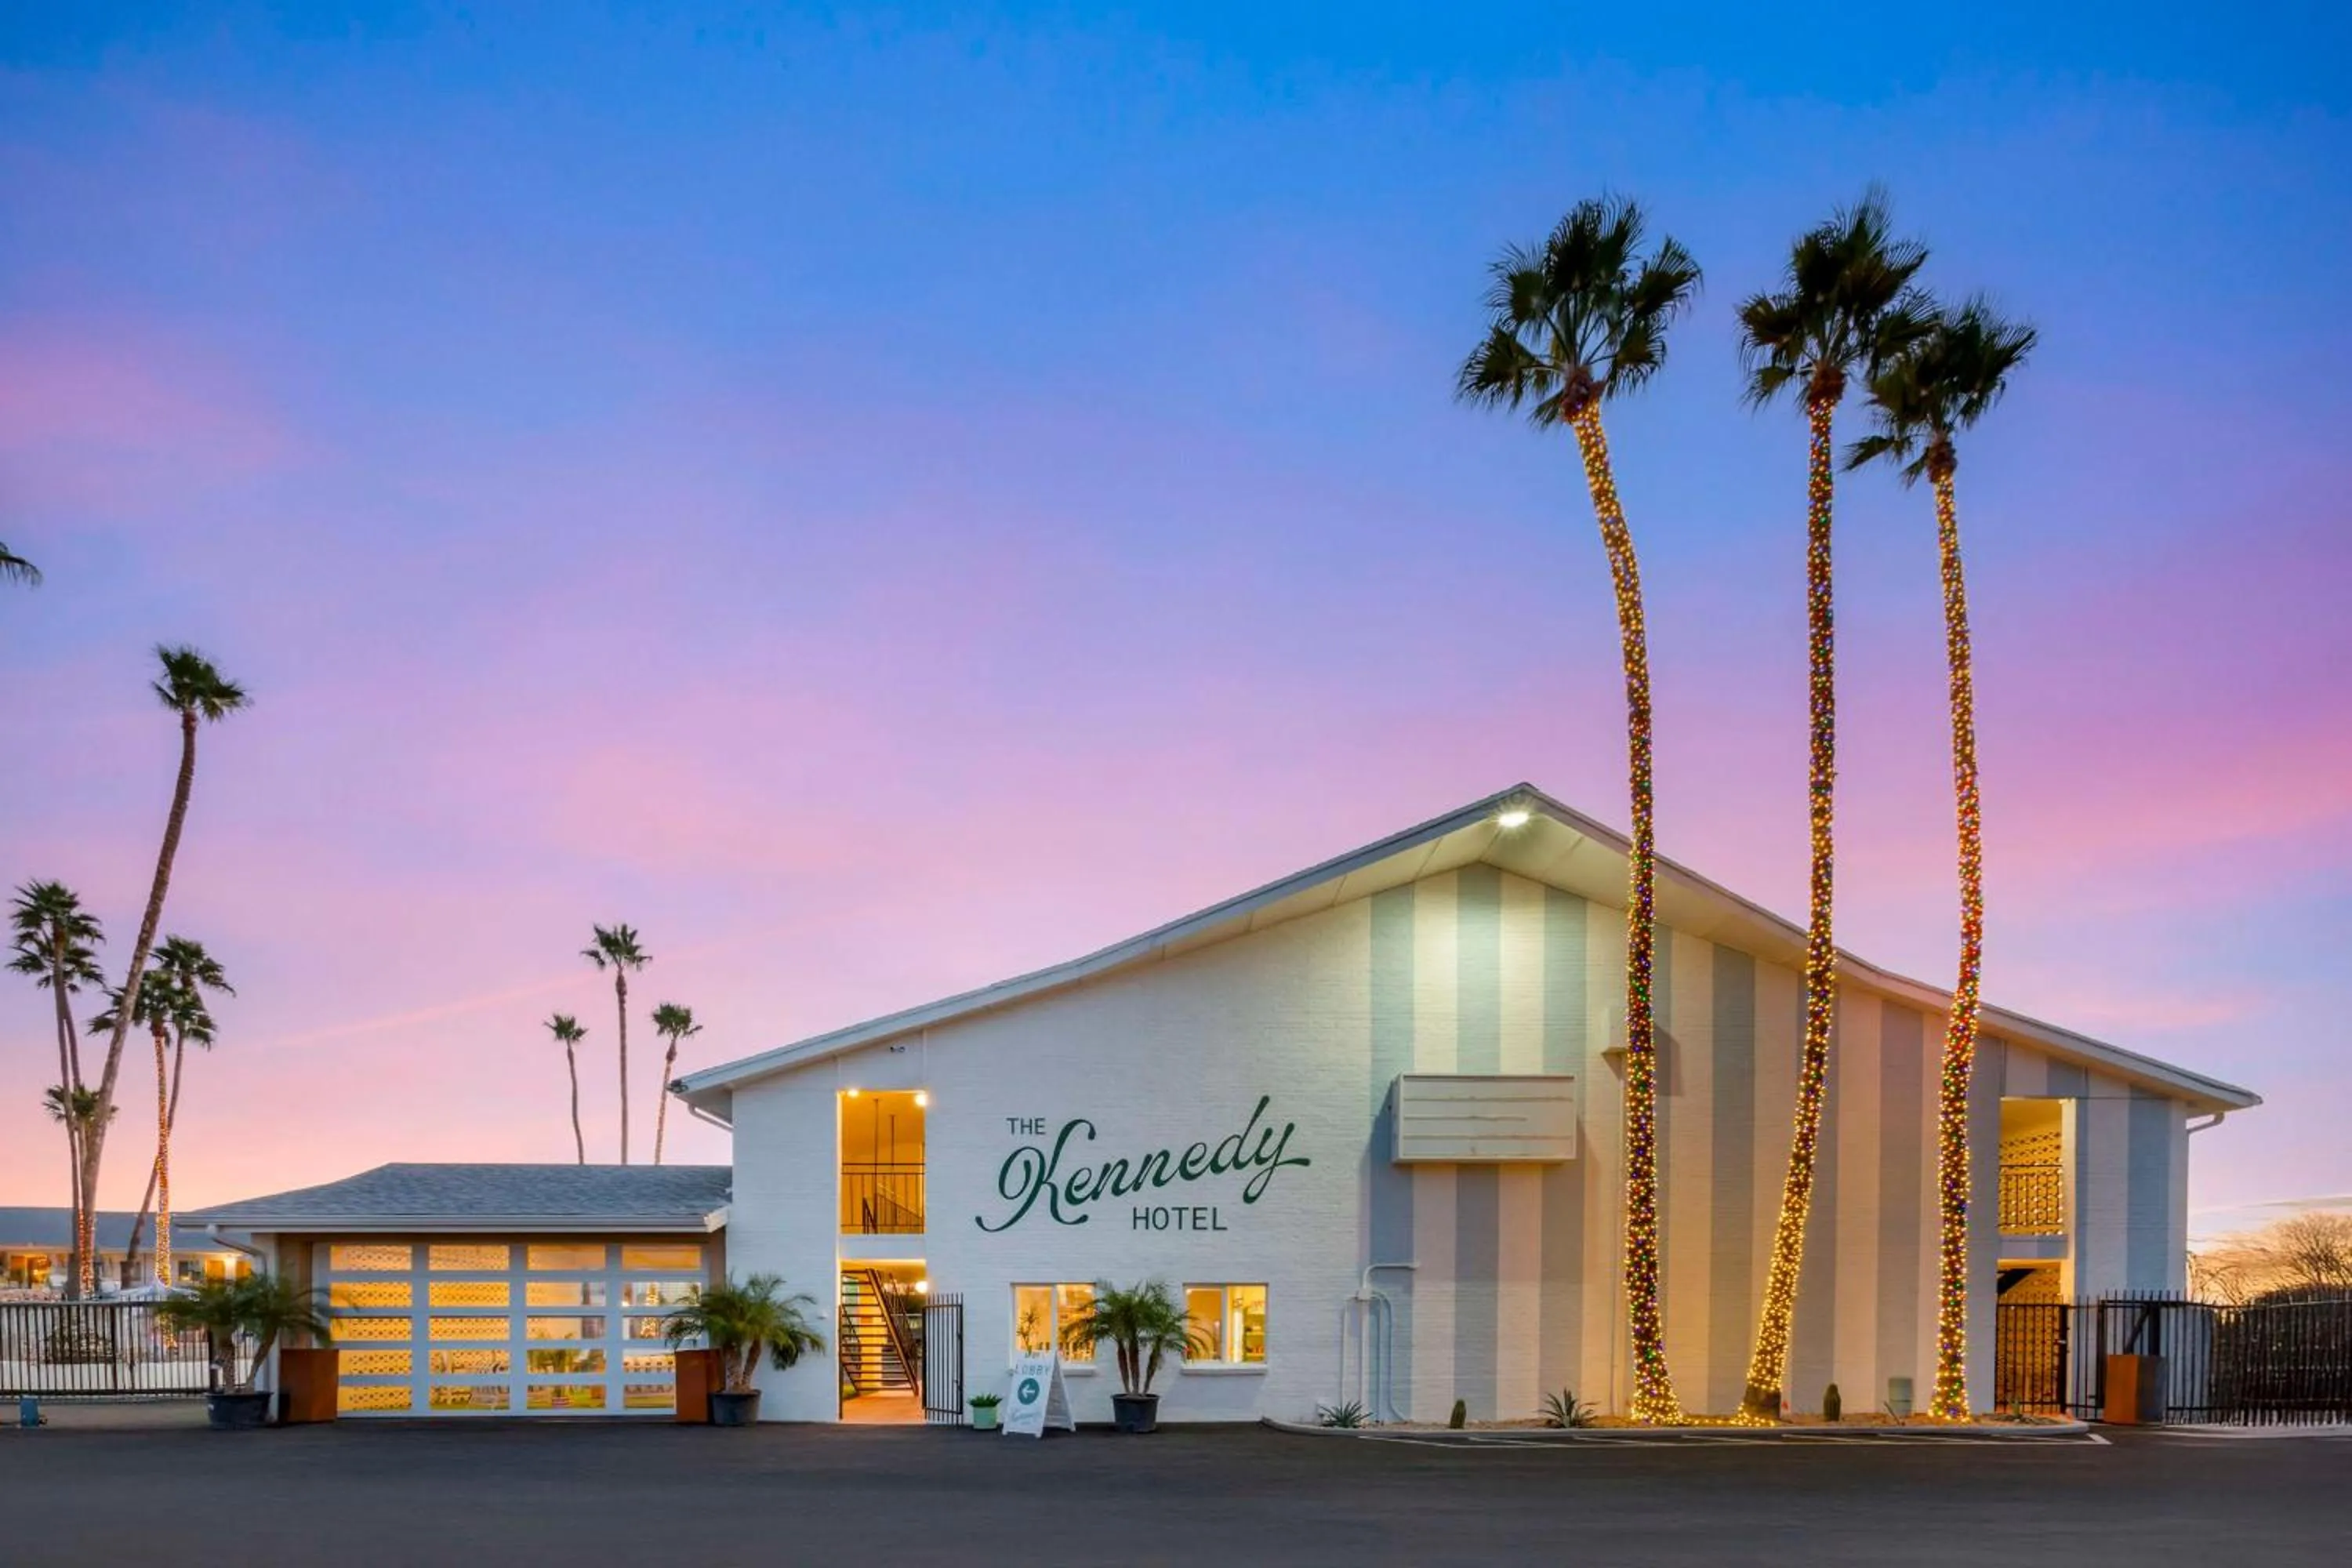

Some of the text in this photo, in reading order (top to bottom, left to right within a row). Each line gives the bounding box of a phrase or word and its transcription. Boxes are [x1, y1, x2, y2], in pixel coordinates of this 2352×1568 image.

[1007, 1117, 1046, 1135] THE
[975, 1095, 1311, 1232] Kennedy
[1133, 1207, 1228, 1231] HOTEL
